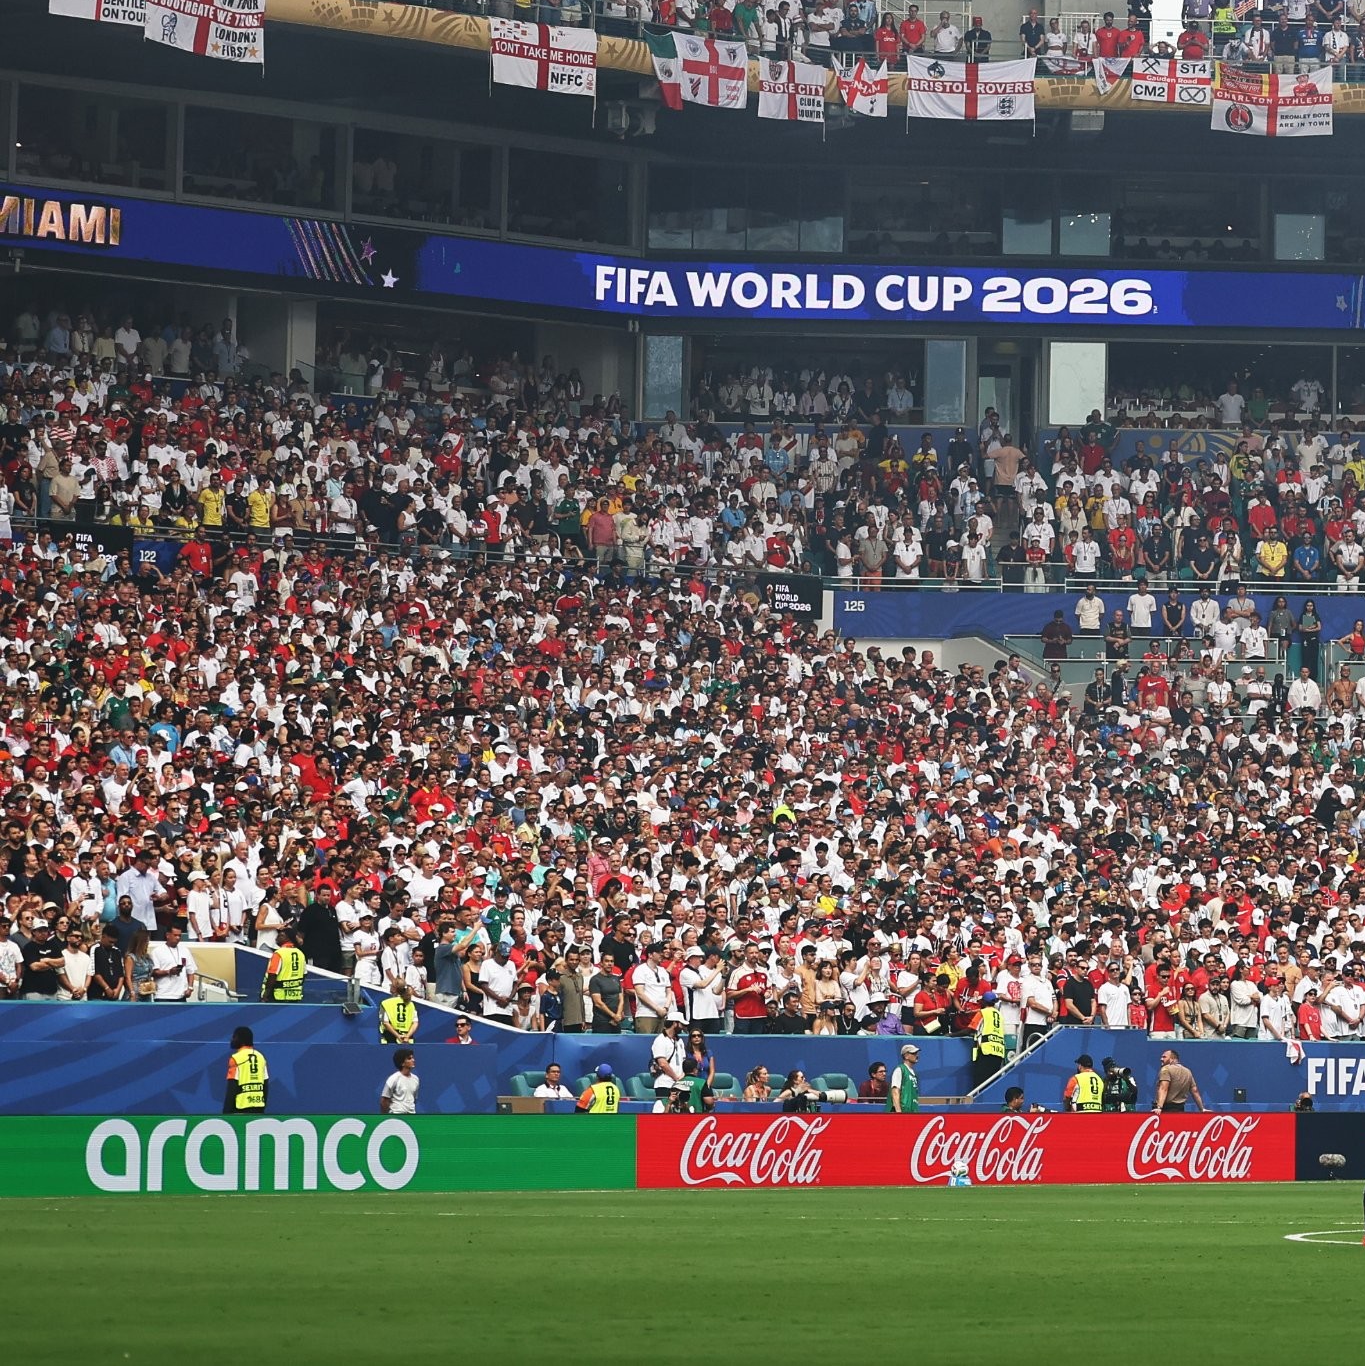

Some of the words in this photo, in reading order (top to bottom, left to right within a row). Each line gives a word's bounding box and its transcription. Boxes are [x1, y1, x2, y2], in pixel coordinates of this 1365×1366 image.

[222, 45, 248, 57] FIRST
[523, 44, 548, 60] TAKE
[550, 50, 564, 62] ME
[566, 52, 593, 66] HOME
[1180, 64, 1206, 74] ST4
[550, 72, 583, 86] NFFC
[911, 80, 970, 93] BRISTOL
[976, 82, 1032, 94] ROVERS
[1134, 85, 1165, 97] CM2
[1217, 91, 1272, 104] CHARLTON
[1279, 96, 1329, 104] ATHLETIC
[595, 265, 677, 306] FIFA
[690, 272, 865, 310] WORLD
[875, 274, 972, 311] CUP
[982, 277, 1154, 314] 2026
[76, 534, 92, 543] FIFA
[139, 550, 156, 562] 122
[775, 593, 798, 602] WORLD
[844, 601, 865, 611] 125
[680, 1116, 831, 1186] Coca-Cola
[911, 1114, 1052, 1184] Coca-Cola
[1127, 1114, 1260, 1181] Coca-Cola
[86, 1118, 419, 1192] aramco
